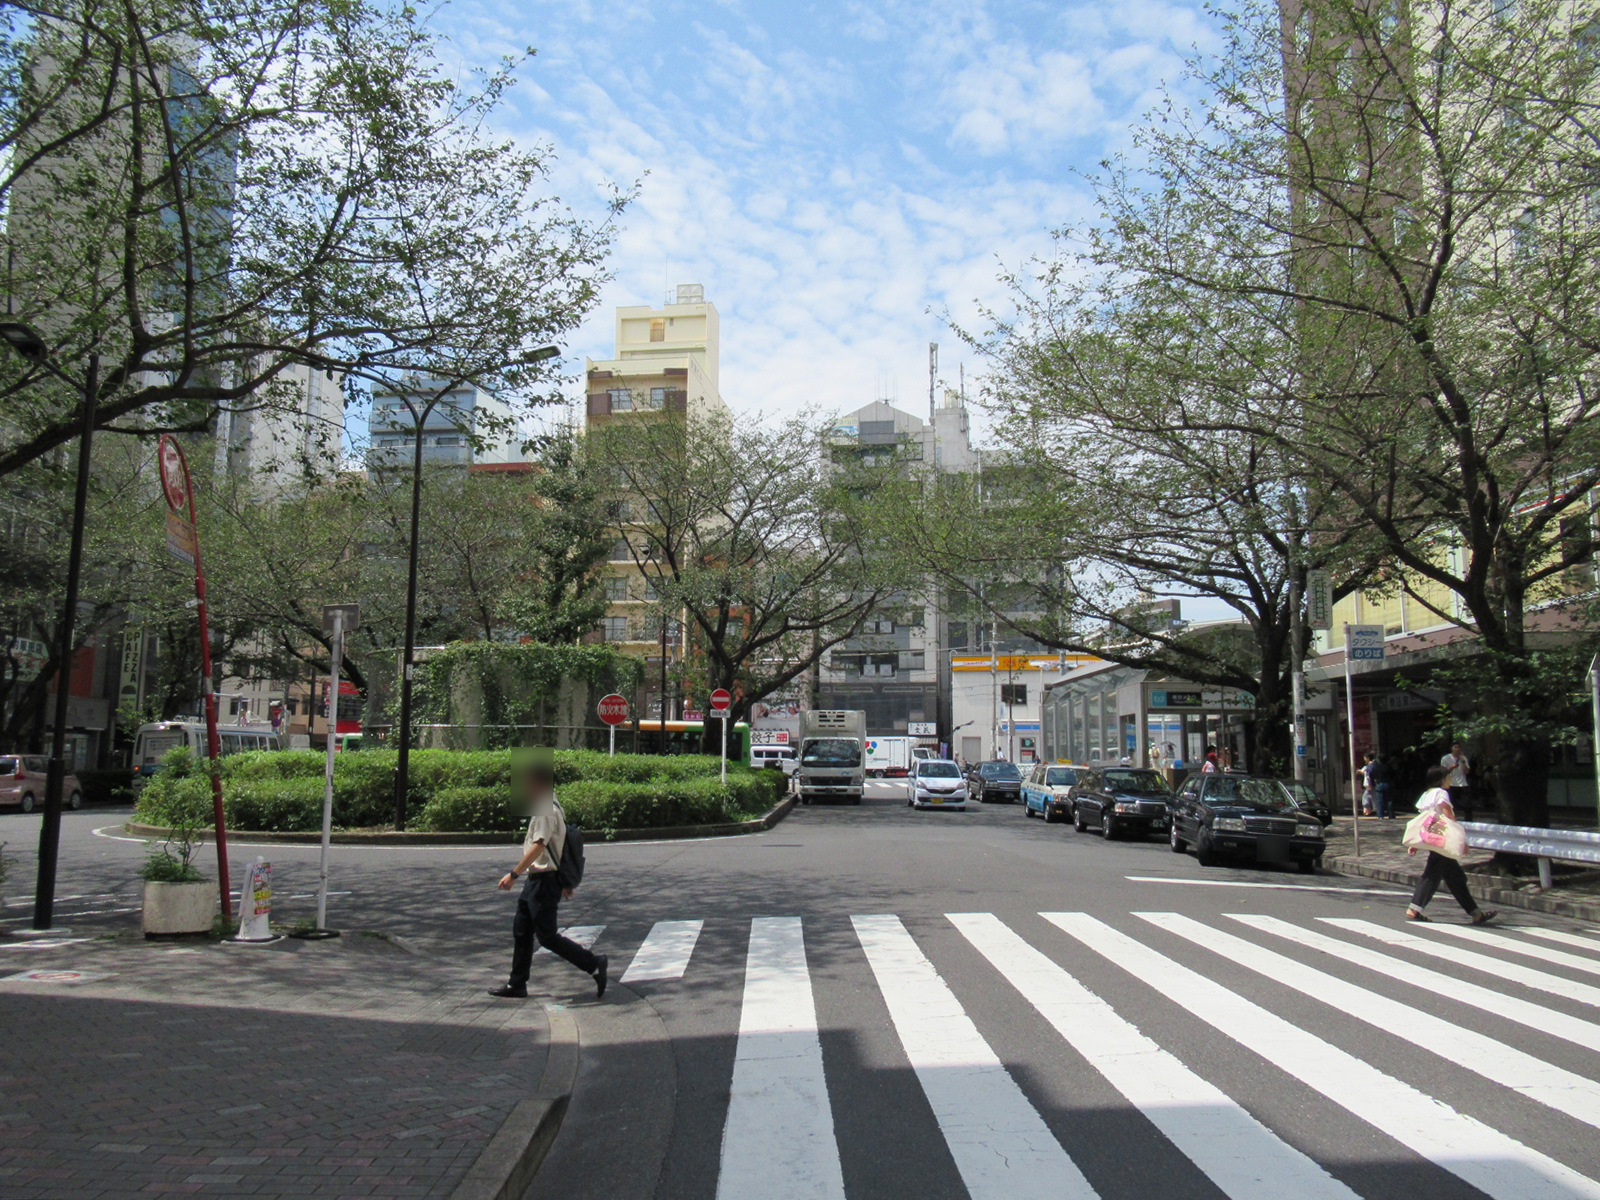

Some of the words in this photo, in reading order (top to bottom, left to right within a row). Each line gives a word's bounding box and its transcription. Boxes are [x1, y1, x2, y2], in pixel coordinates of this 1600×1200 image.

[1352, 638, 1383, 646] タクシー
[124, 632, 133, 673] CAFE
[130, 632, 140, 683] PIZZA
[1354, 649, 1382, 658] のりば
[751, 731, 775, 744] 餃子
